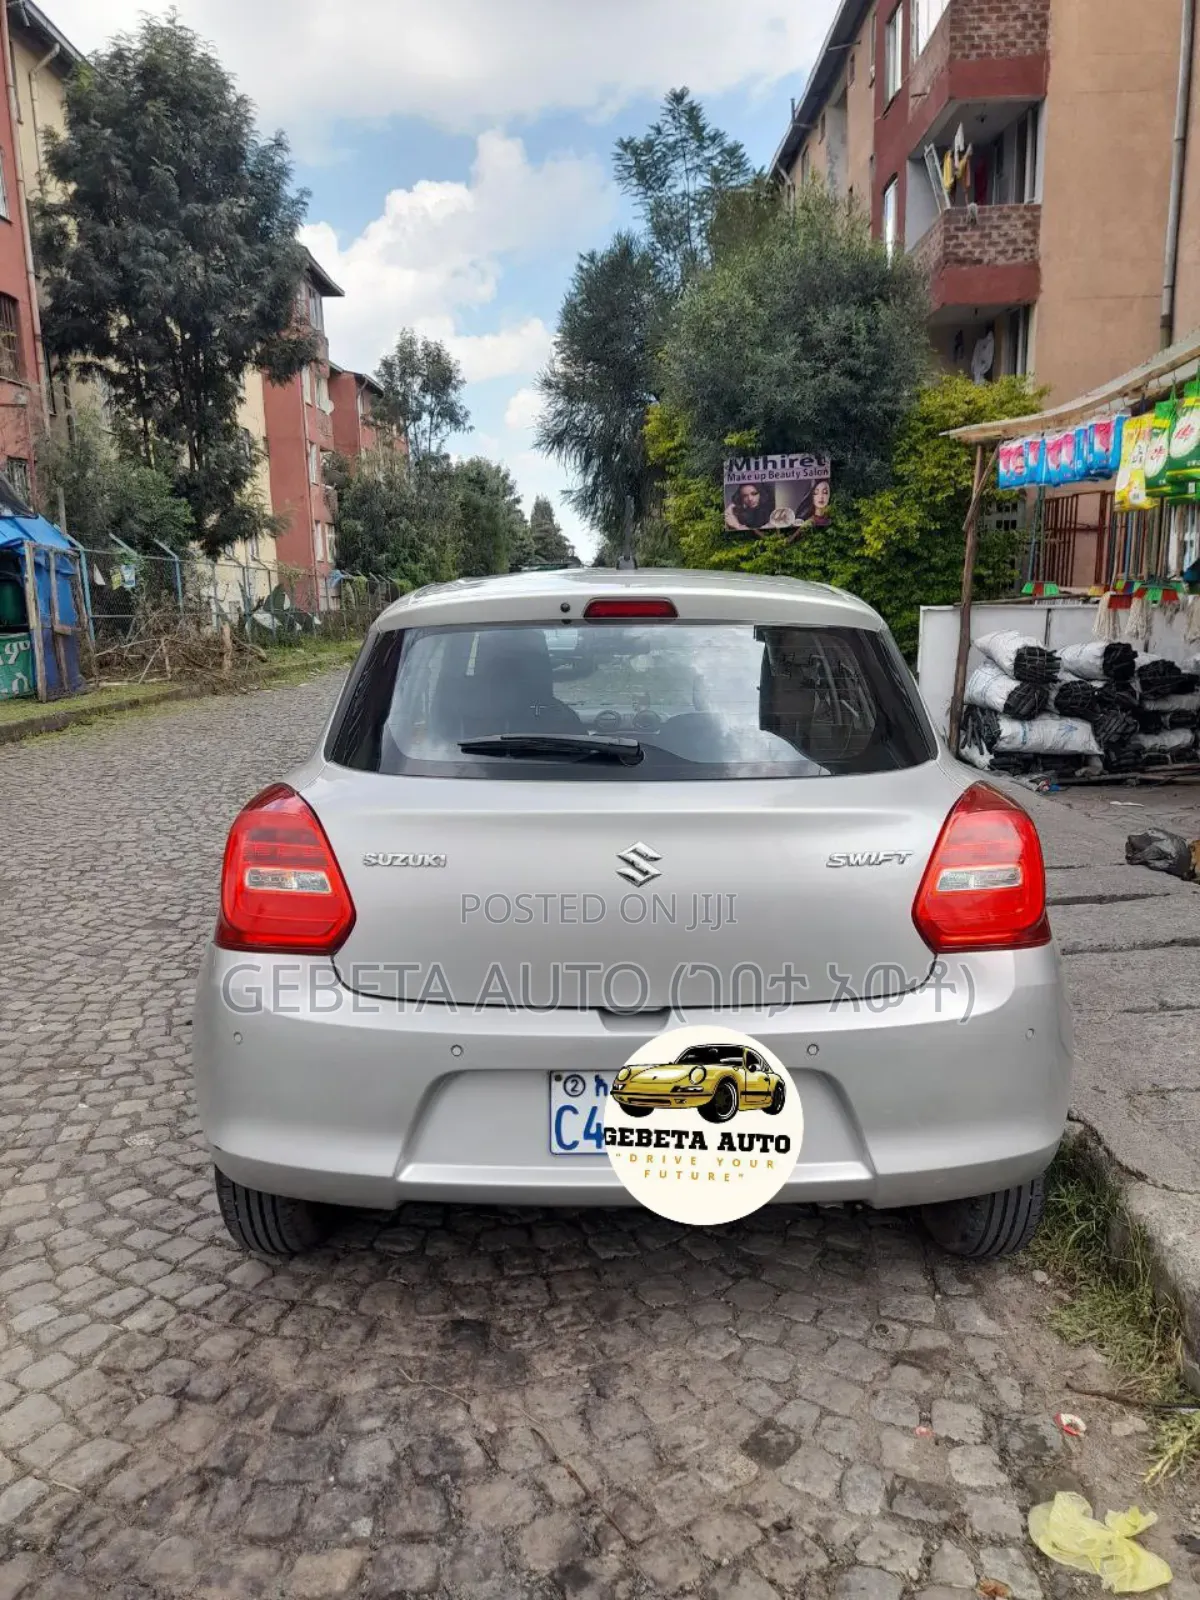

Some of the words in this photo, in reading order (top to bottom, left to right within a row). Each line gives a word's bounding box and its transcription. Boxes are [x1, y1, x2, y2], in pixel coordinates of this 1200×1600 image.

[727, 472, 752, 482] Make
[755, 473, 766, 482] up
[768, 470, 801, 480] Beauty
[803, 468, 829, 477] Salon
[363, 852, 447, 867] SUZUKI
[826, 850, 913, 868] SWIFT
